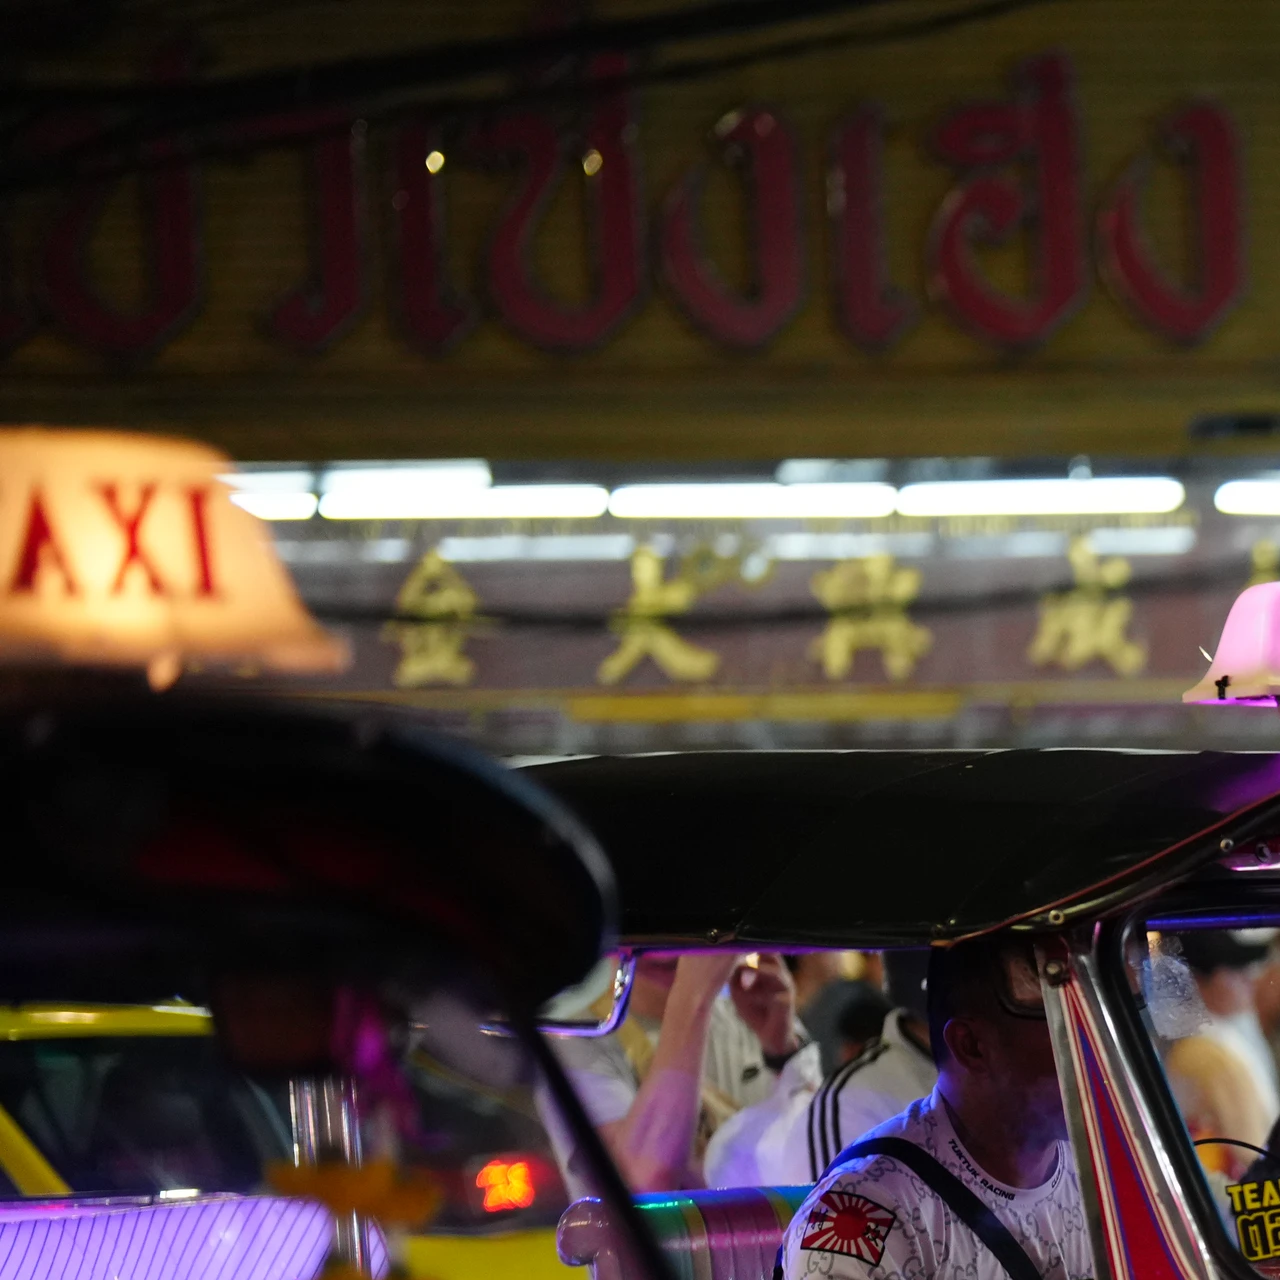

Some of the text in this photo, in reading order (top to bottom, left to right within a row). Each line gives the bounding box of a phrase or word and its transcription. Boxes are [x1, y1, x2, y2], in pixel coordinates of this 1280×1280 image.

[8, 479, 224, 602] AXI
[948, 1138, 1016, 1201] TUKTUK RACING
